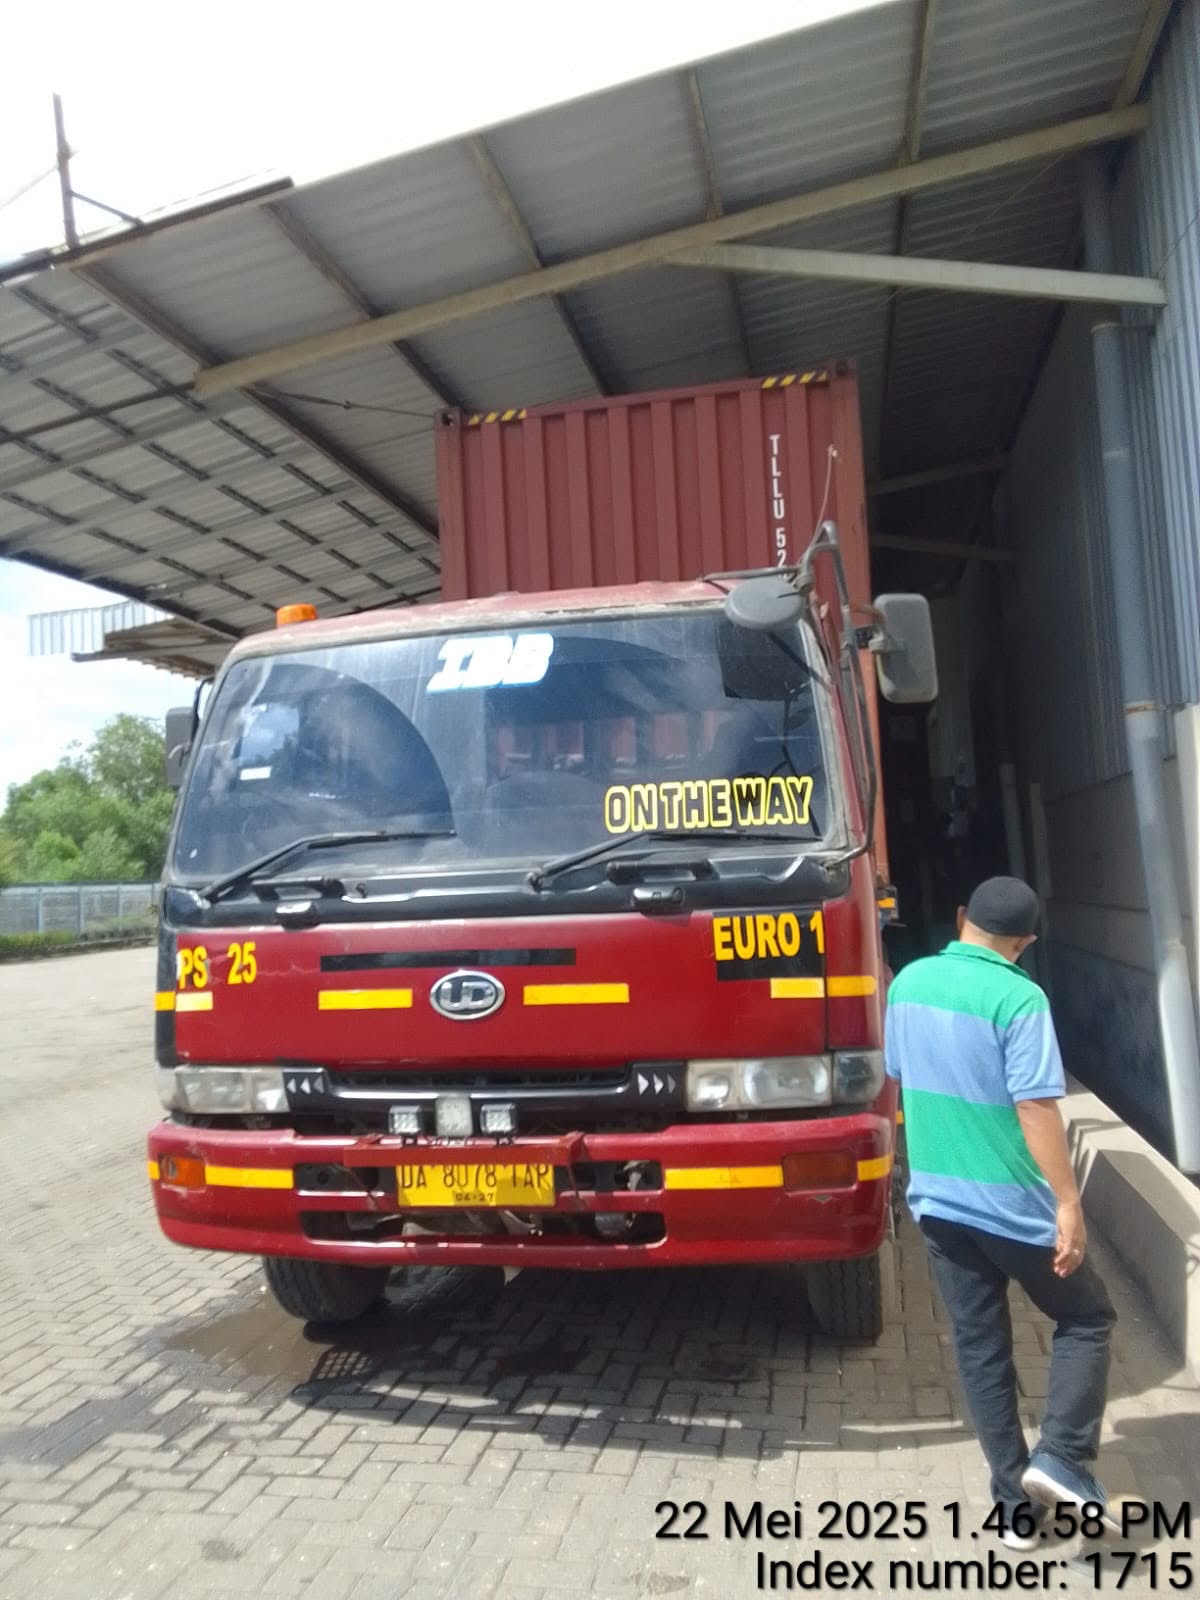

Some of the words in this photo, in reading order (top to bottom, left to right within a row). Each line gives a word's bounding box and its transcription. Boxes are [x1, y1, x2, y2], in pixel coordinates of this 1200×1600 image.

[769, 434, 785, 520] TLLU
[775, 527, 790, 578] 52
[713, 912, 801, 961] EURO
[809, 910, 825, 954] 1
[177, 945, 208, 989] PS
[227, 941, 257, 985] 25
[440, 981, 496, 1011] UD
[402, 1164, 427, 1189] DA
[443, 1164, 497, 1188] 8078
